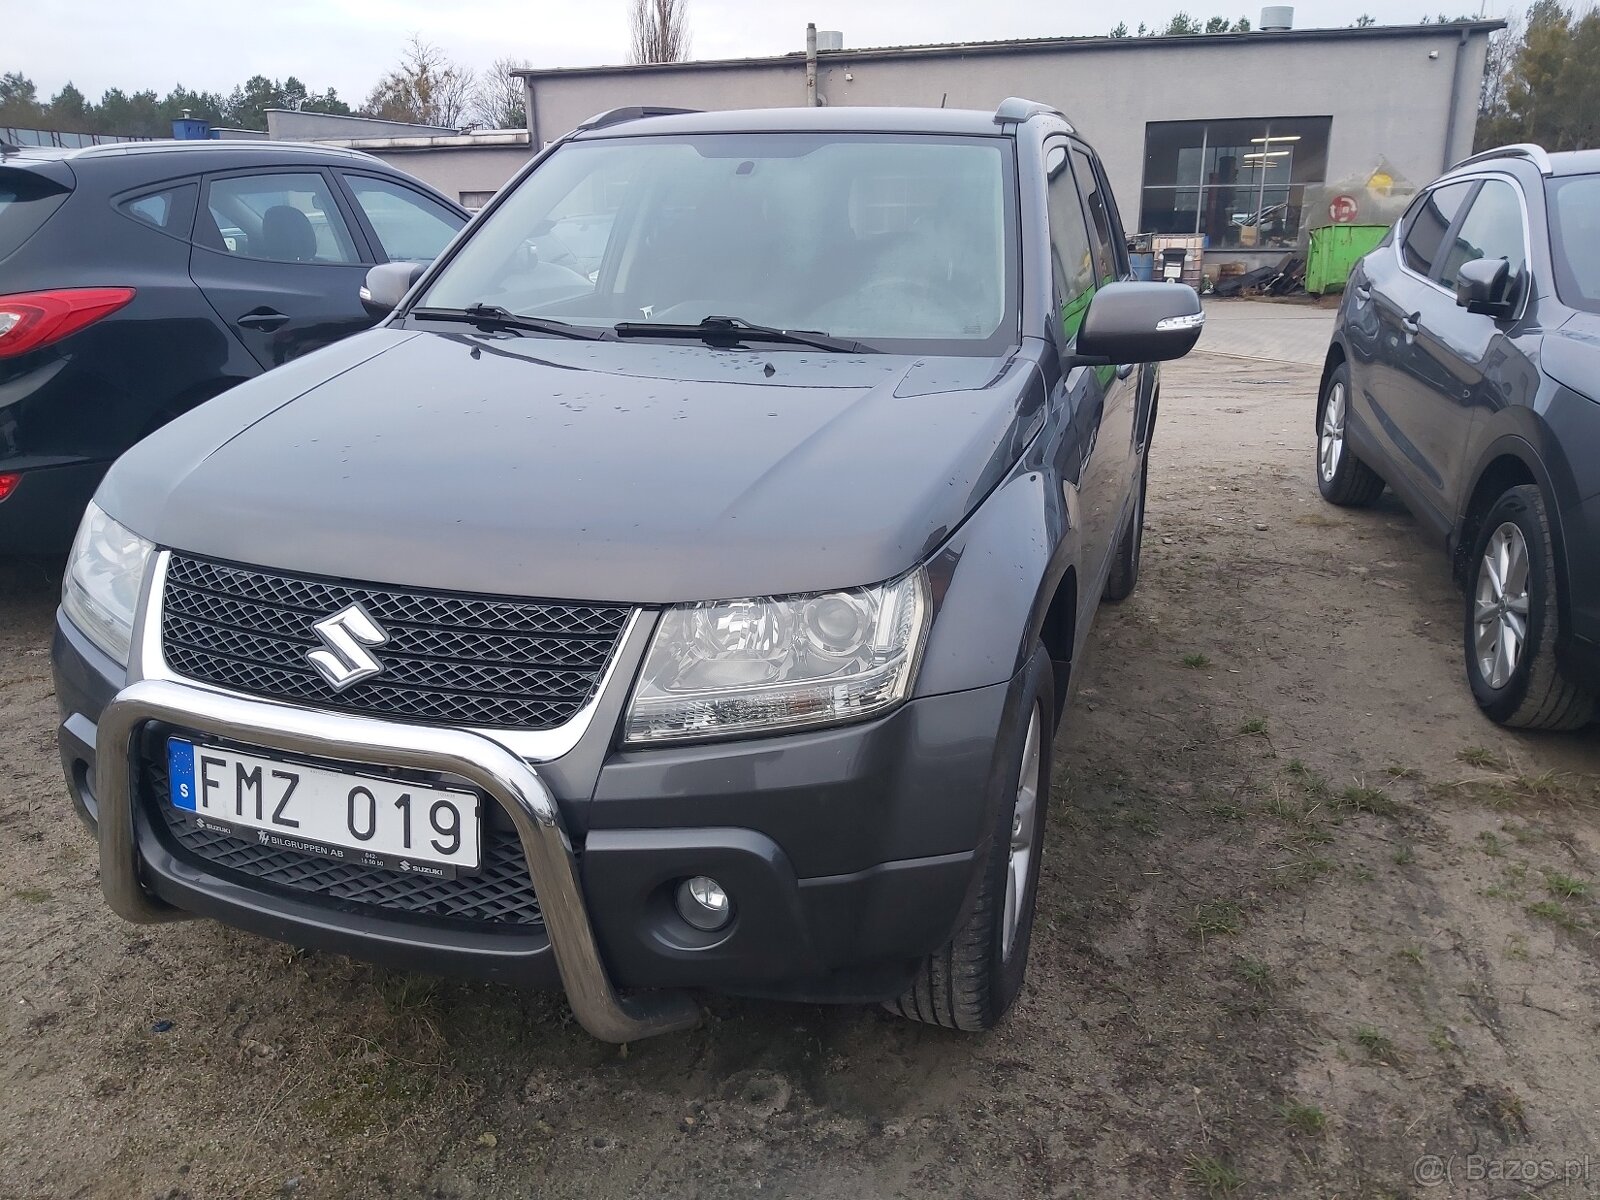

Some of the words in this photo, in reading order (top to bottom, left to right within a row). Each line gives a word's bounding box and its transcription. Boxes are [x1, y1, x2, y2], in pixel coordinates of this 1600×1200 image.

[179, 783, 189, 798] S
[200, 755, 300, 829] FMZ
[347, 785, 461, 856] 019
[206, 823, 231, 834] SUZUKI
[271, 836, 328, 855] BILGRUPPEN
[330, 849, 344, 858] AB
[412, 865, 443, 876] SUZUKI
